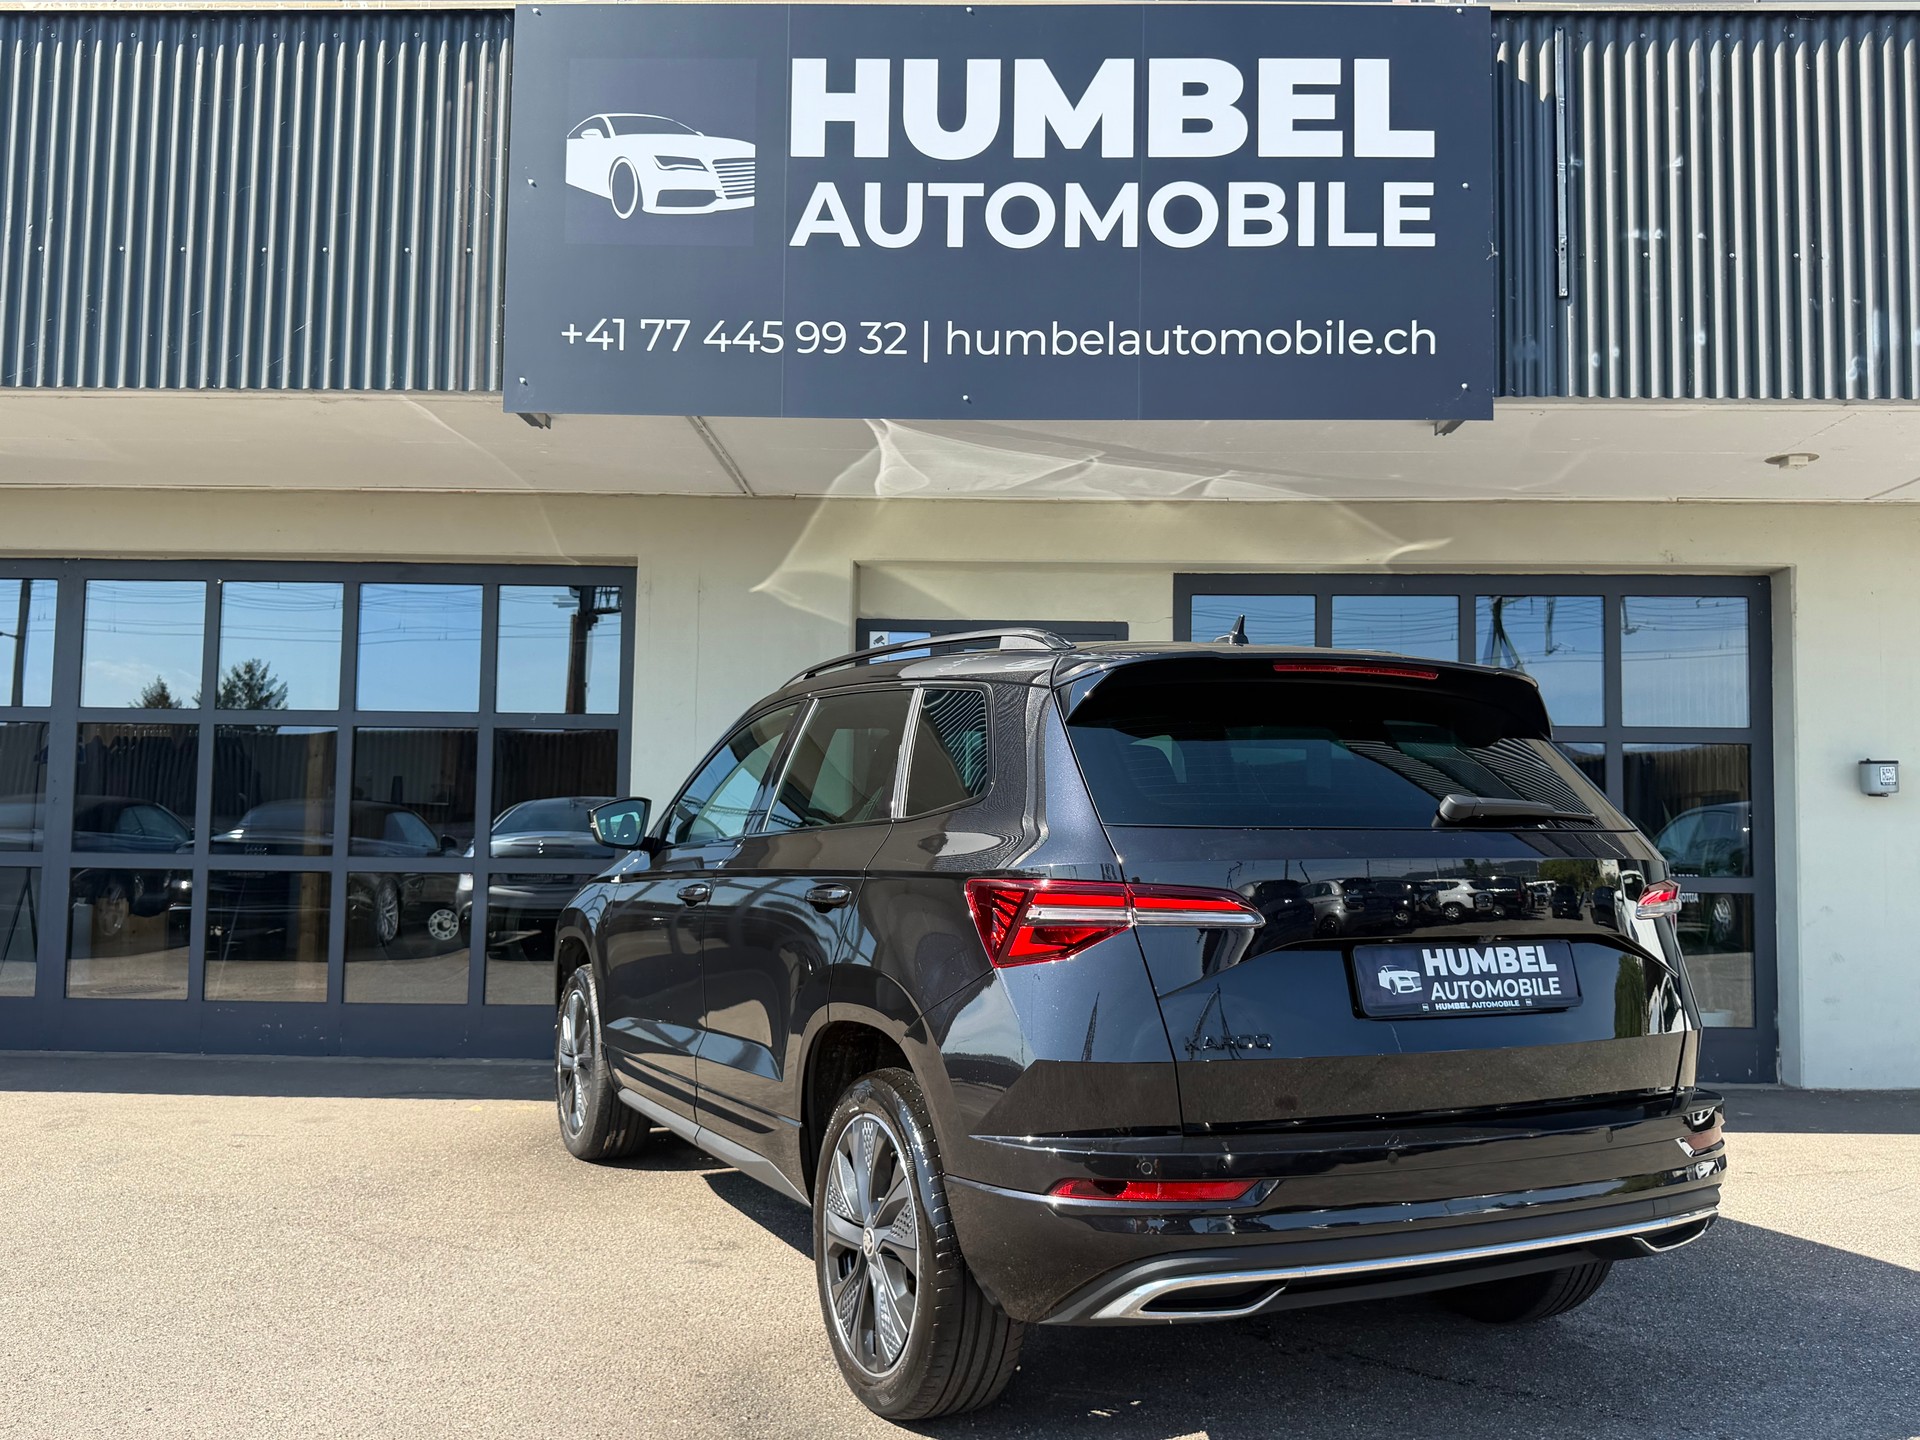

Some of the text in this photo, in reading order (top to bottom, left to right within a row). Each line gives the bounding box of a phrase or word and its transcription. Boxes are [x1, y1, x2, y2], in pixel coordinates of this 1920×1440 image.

[789, 57, 1436, 161] HUMBEL
[788, 180, 1436, 250] AUTOMOBILE
[560, 317, 625, 351] +41
[640, 318, 691, 352] 77
[702, 319, 785, 354] 445
[795, 320, 847, 355] 99
[858, 321, 908, 355] 32
[946, 319, 1436, 356] humbelautomobile.ch
[1421, 945, 1558, 977] HUMBEL
[1431, 976, 1562, 1000] AUTOMOBILE
[1435, 999, 1521, 1011] HUMBEL AUTOMOBILE
